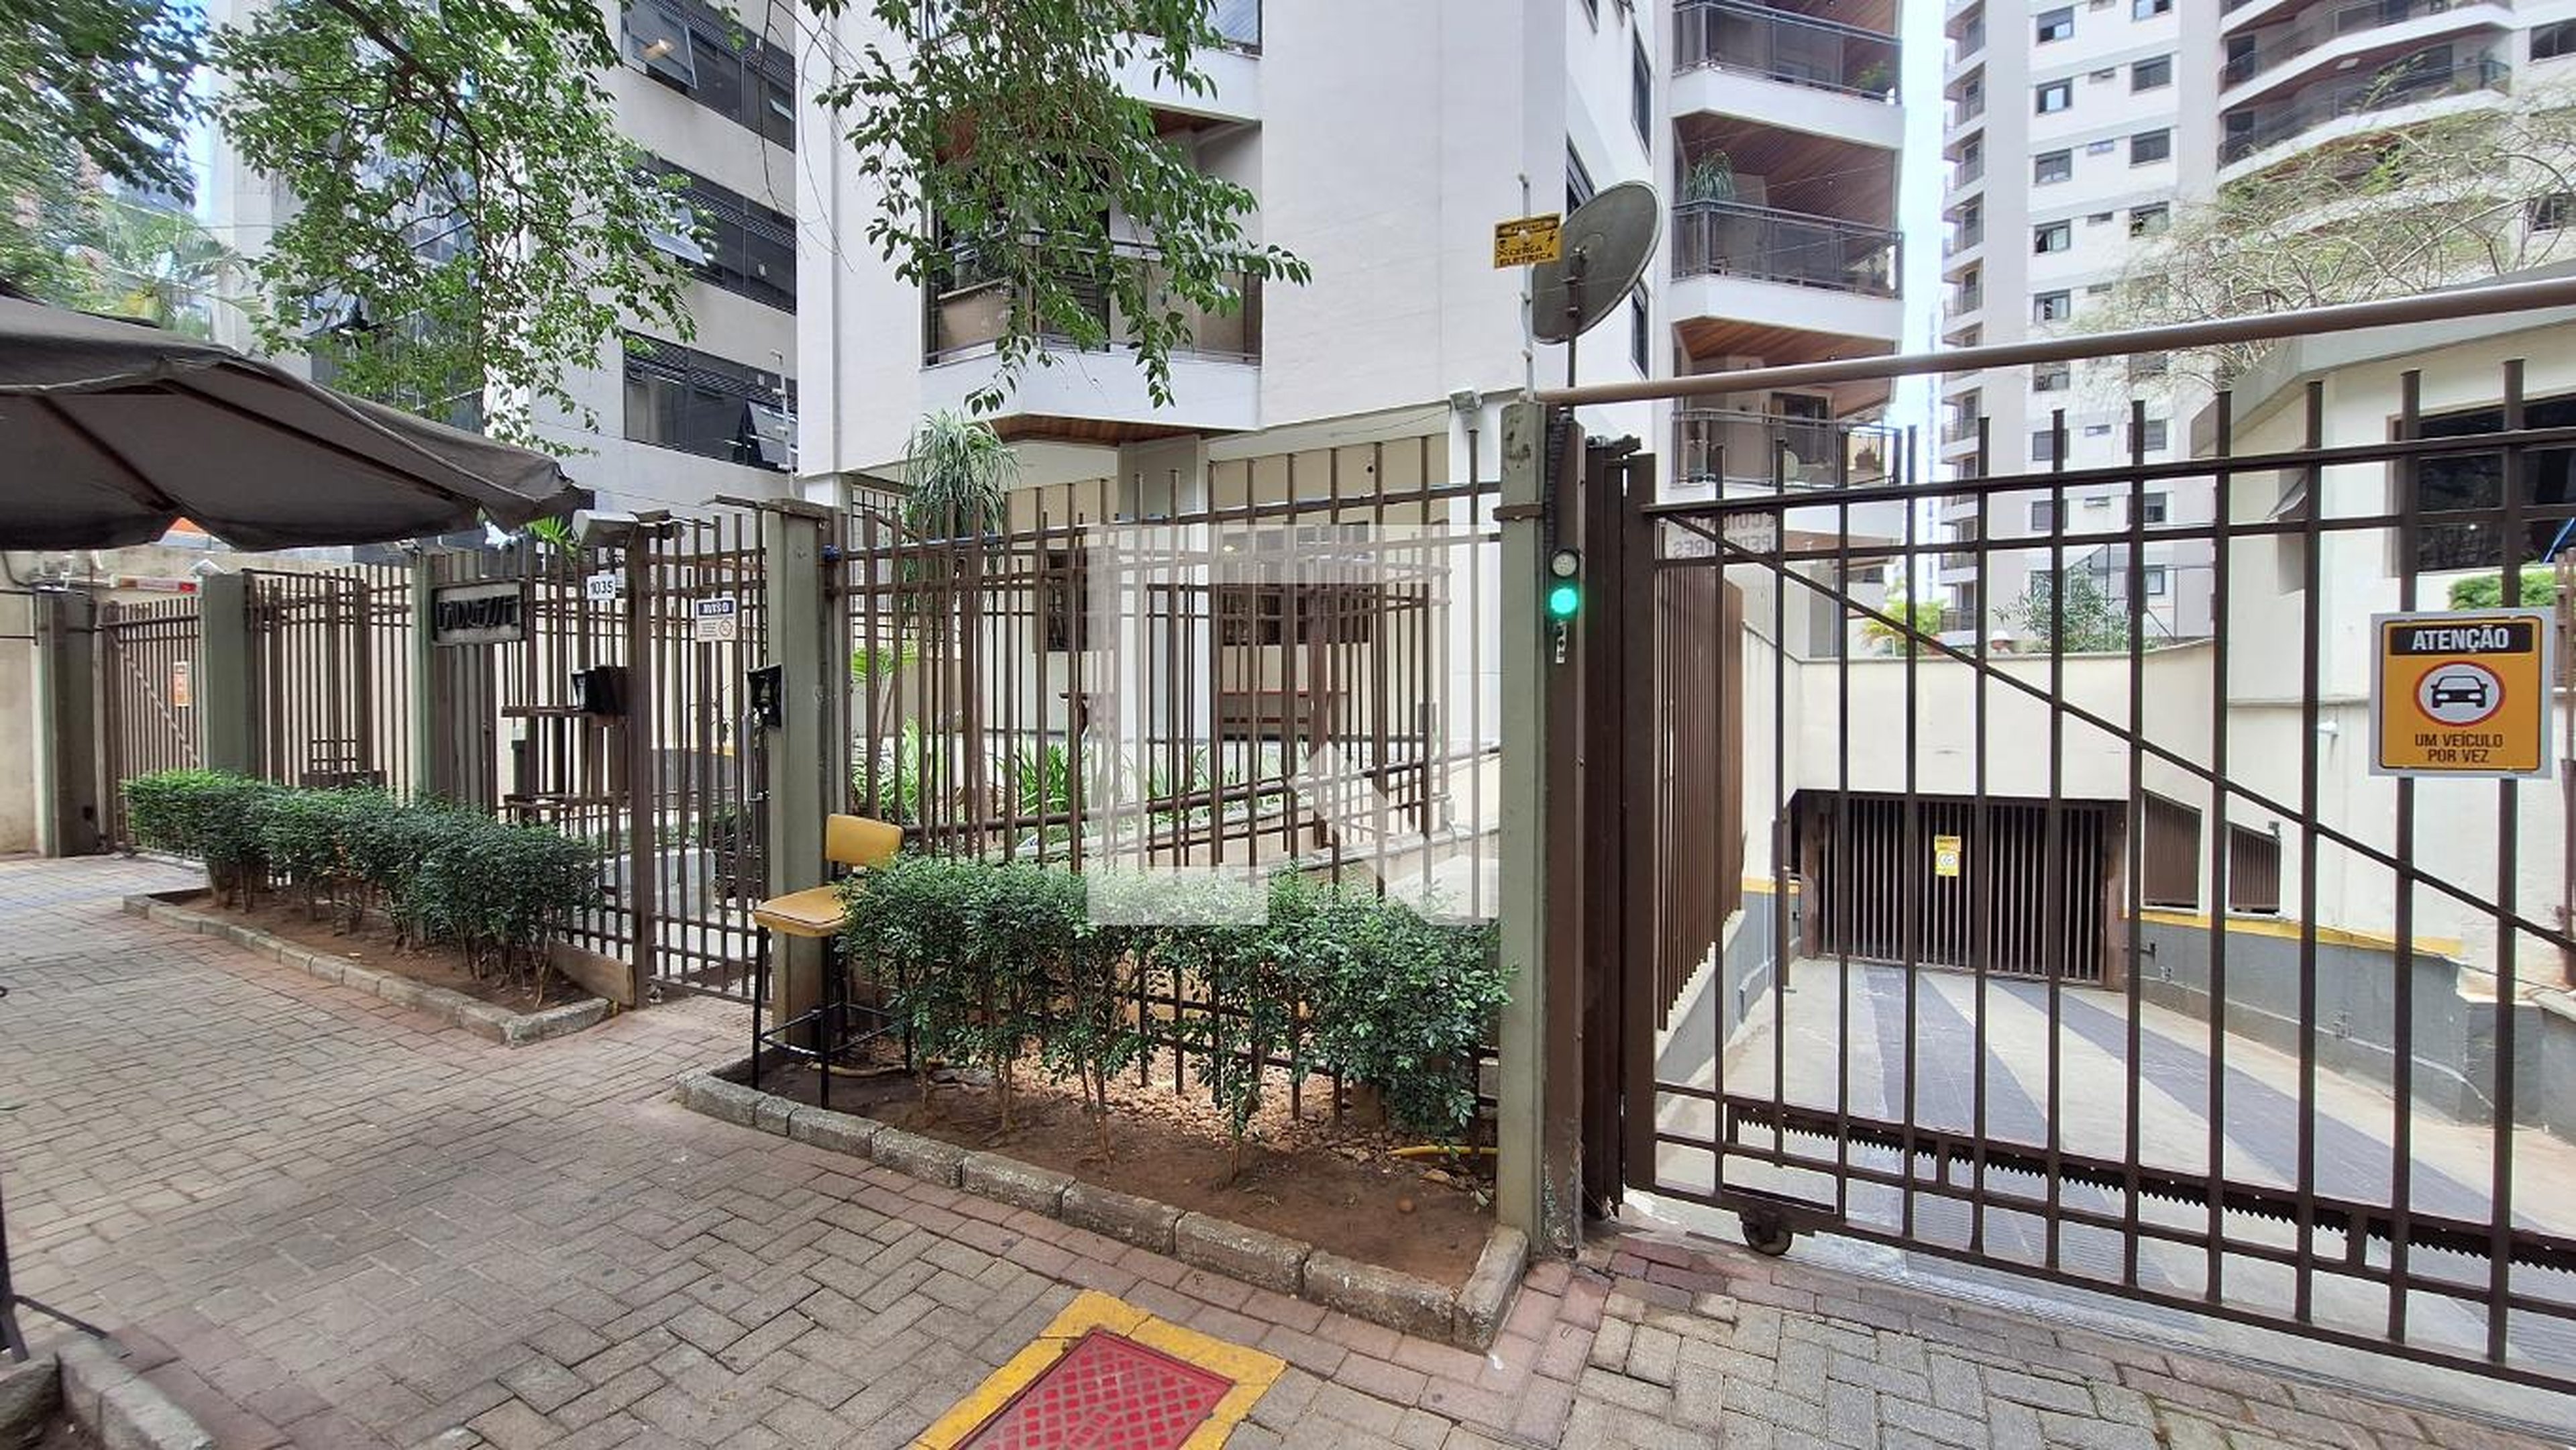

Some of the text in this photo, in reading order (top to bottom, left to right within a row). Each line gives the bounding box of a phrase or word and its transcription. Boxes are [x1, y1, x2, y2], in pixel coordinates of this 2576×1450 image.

[591, 581, 613, 594] 1035
[2412, 624, 2509, 653] ATENÇÃO
[2415, 731, 2504, 748] UM VEÍCULO
[2428, 749, 2489, 763] POR VEZ
